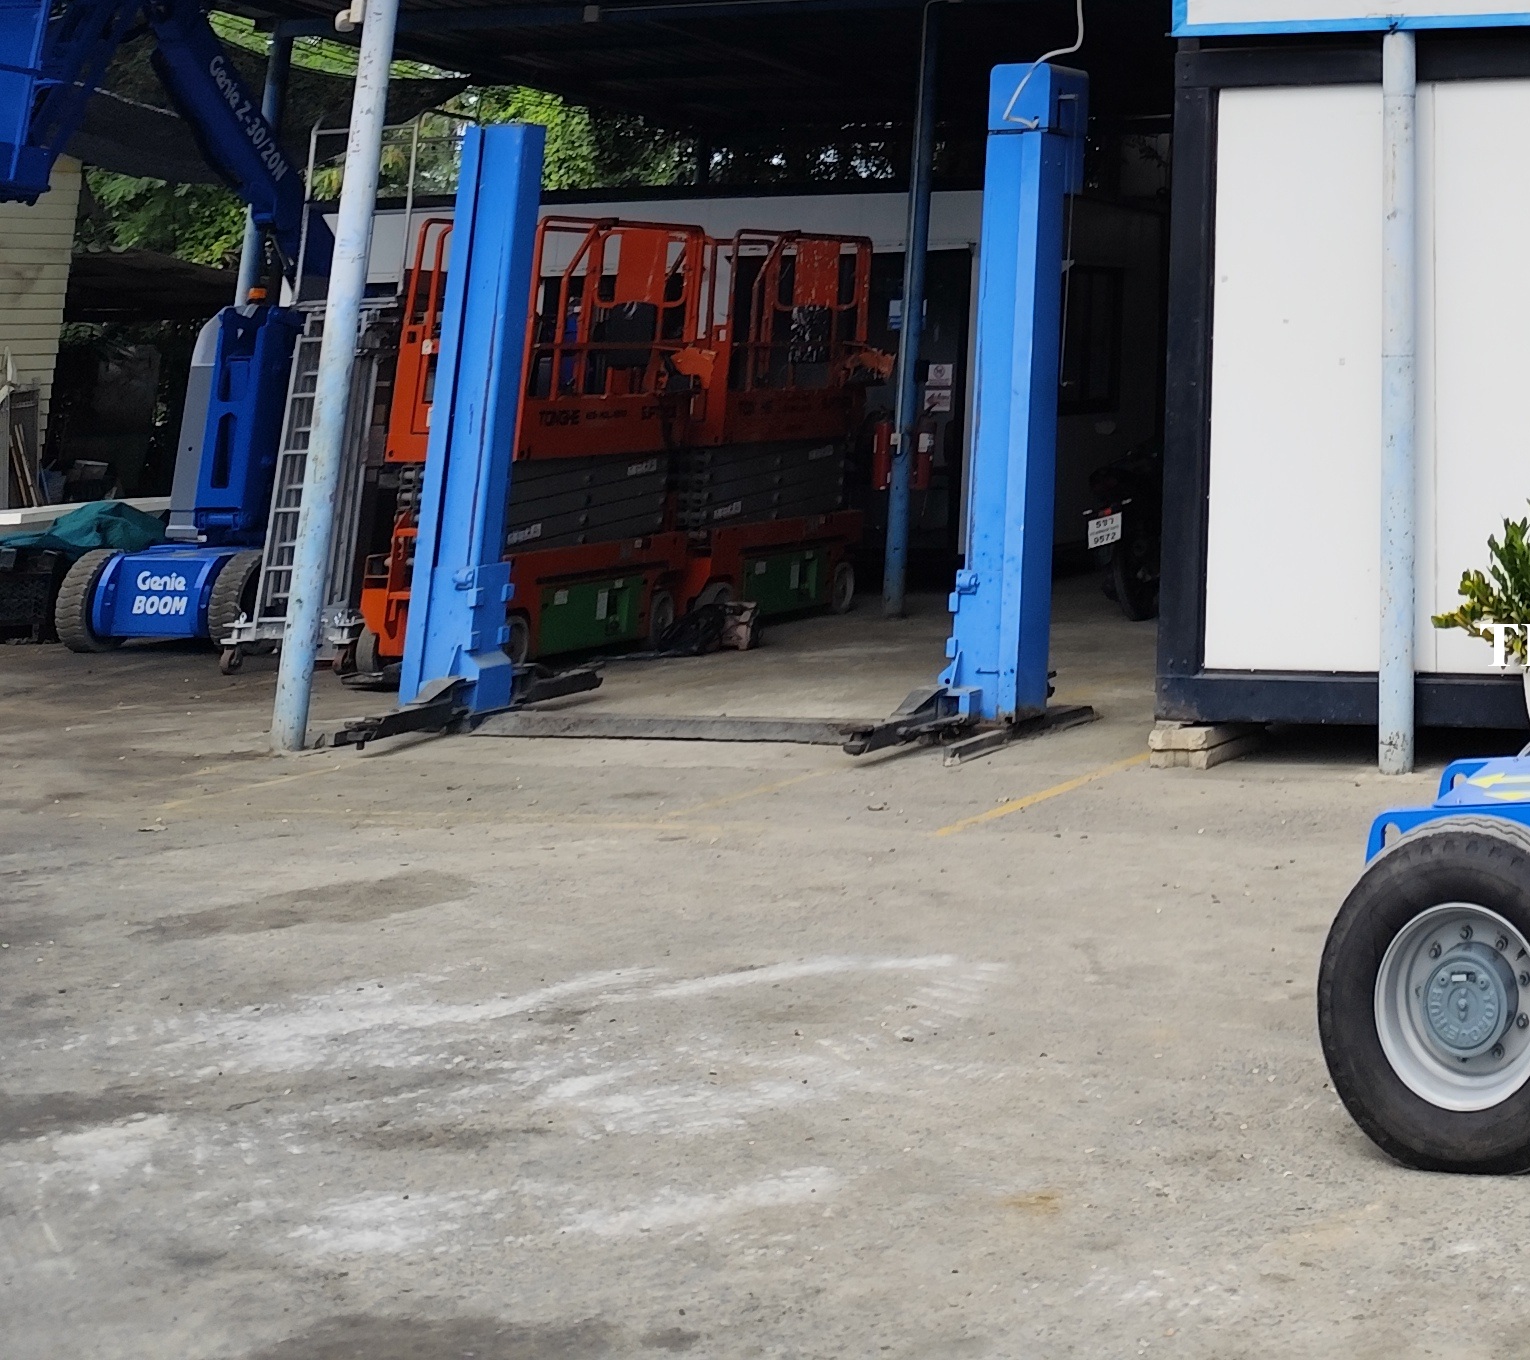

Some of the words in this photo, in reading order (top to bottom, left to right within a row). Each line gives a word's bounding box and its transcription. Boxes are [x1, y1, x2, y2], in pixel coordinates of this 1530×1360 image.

[209, 55, 240, 109] Genie
[137, 570, 187, 591] Genie
[131, 595, 189, 616] BOOM
